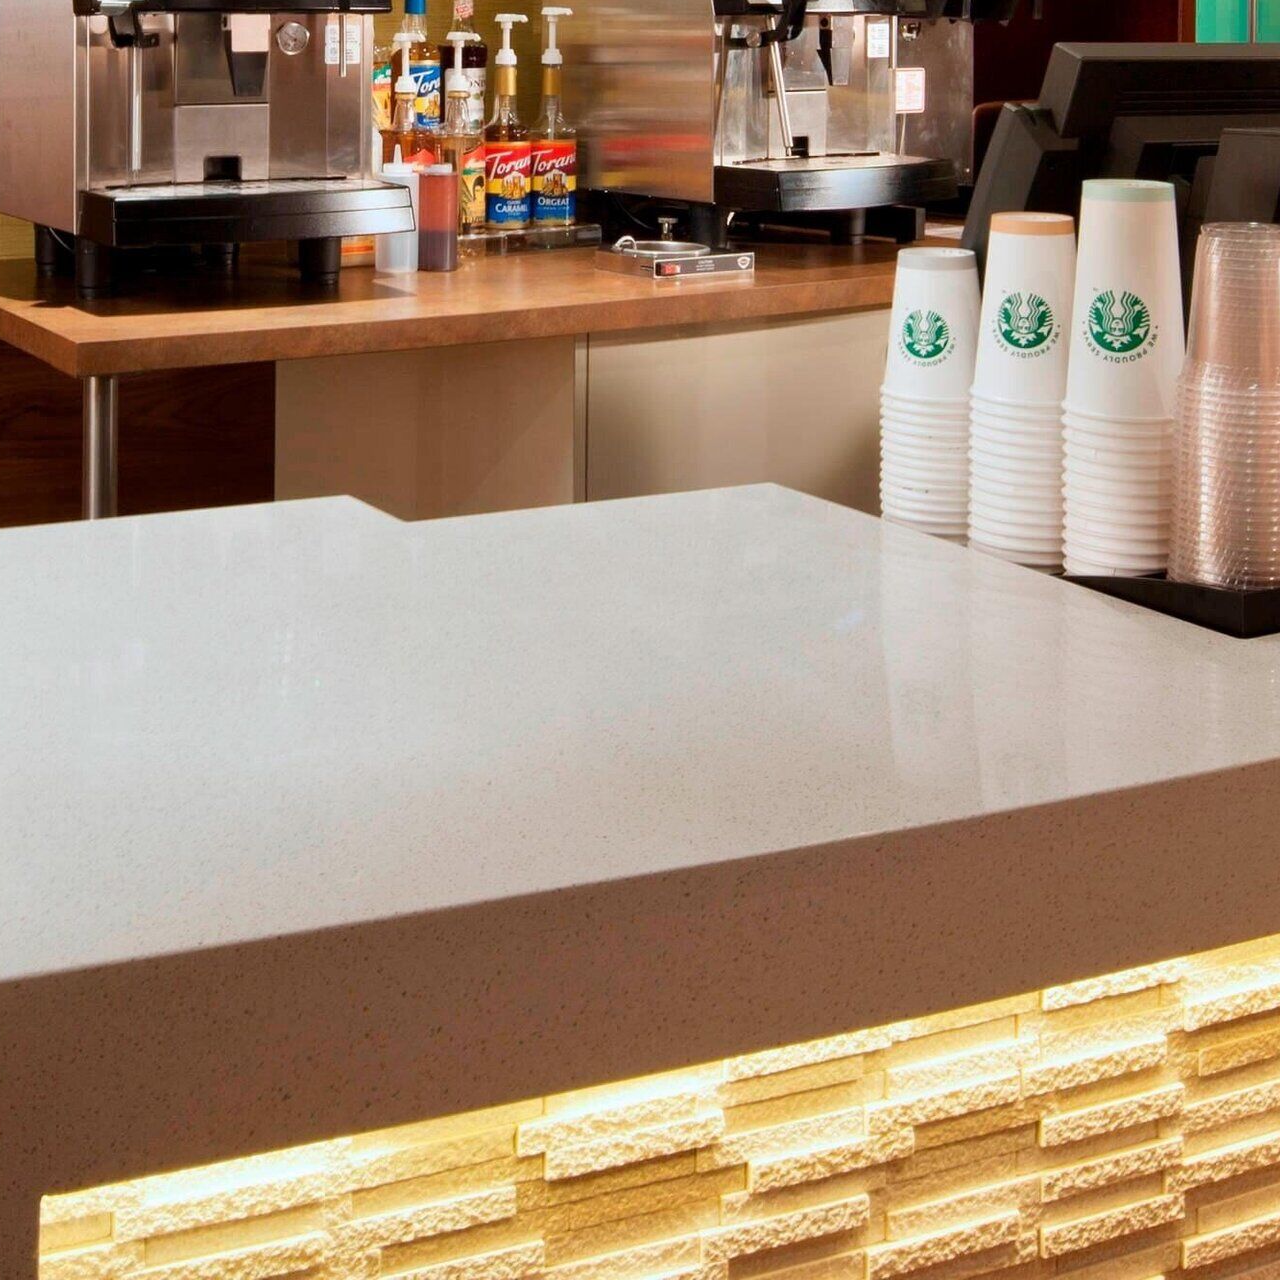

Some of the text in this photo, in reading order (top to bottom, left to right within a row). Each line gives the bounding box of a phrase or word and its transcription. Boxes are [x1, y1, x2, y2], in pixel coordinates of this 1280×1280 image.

[538, 197, 570, 206] ORGEAT
[1147, 334, 1158, 347] WE
[1010, 346, 1051, 359] PROUDLY
[1103, 348, 1148, 364] PROUDLY
